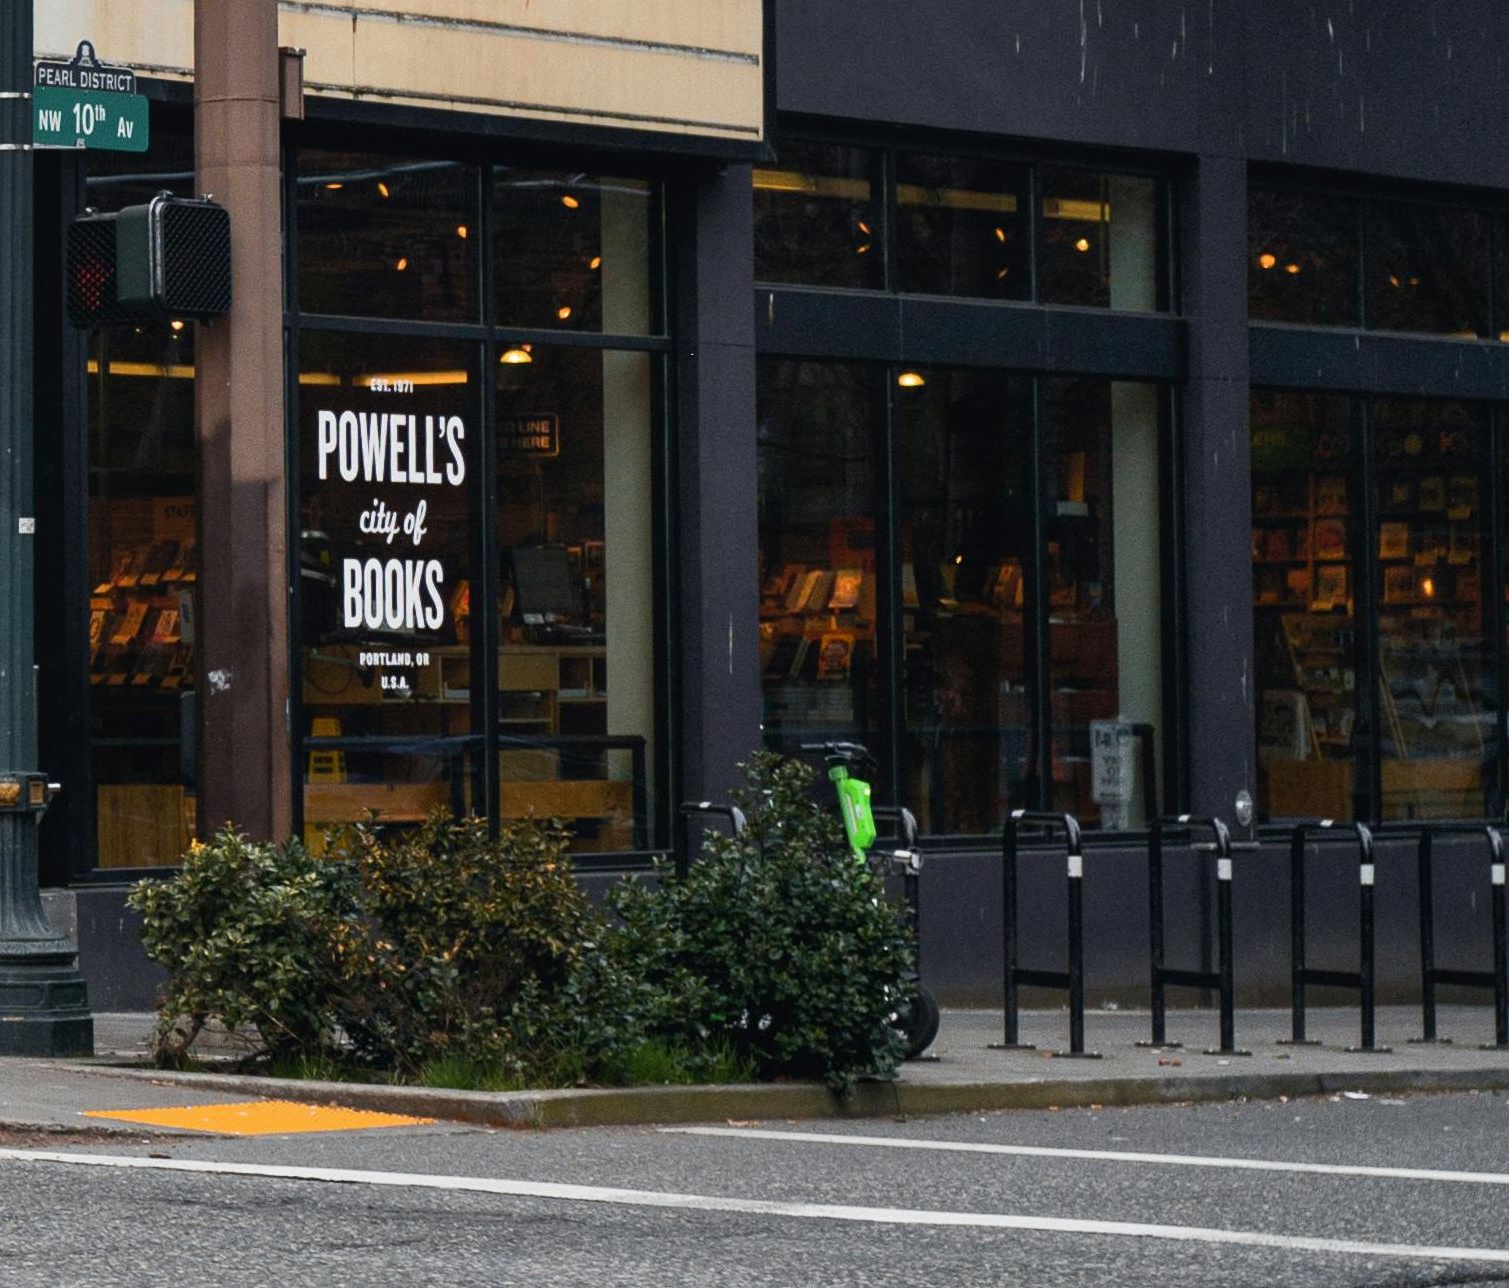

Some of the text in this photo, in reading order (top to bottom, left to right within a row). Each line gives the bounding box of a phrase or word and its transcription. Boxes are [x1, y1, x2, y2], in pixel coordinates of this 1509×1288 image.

[37, 67, 133, 92] PEARL DISTRICT
[38, 102, 134, 139] NW 10th Av
[317, 409, 466, 487] POWELL'S
[359, 497, 427, 546] city of
[342, 557, 445, 631] BOOKS
[359, 651, 430, 668] PORTLAND, OR
[380, 675, 410, 690] U.S.A.
